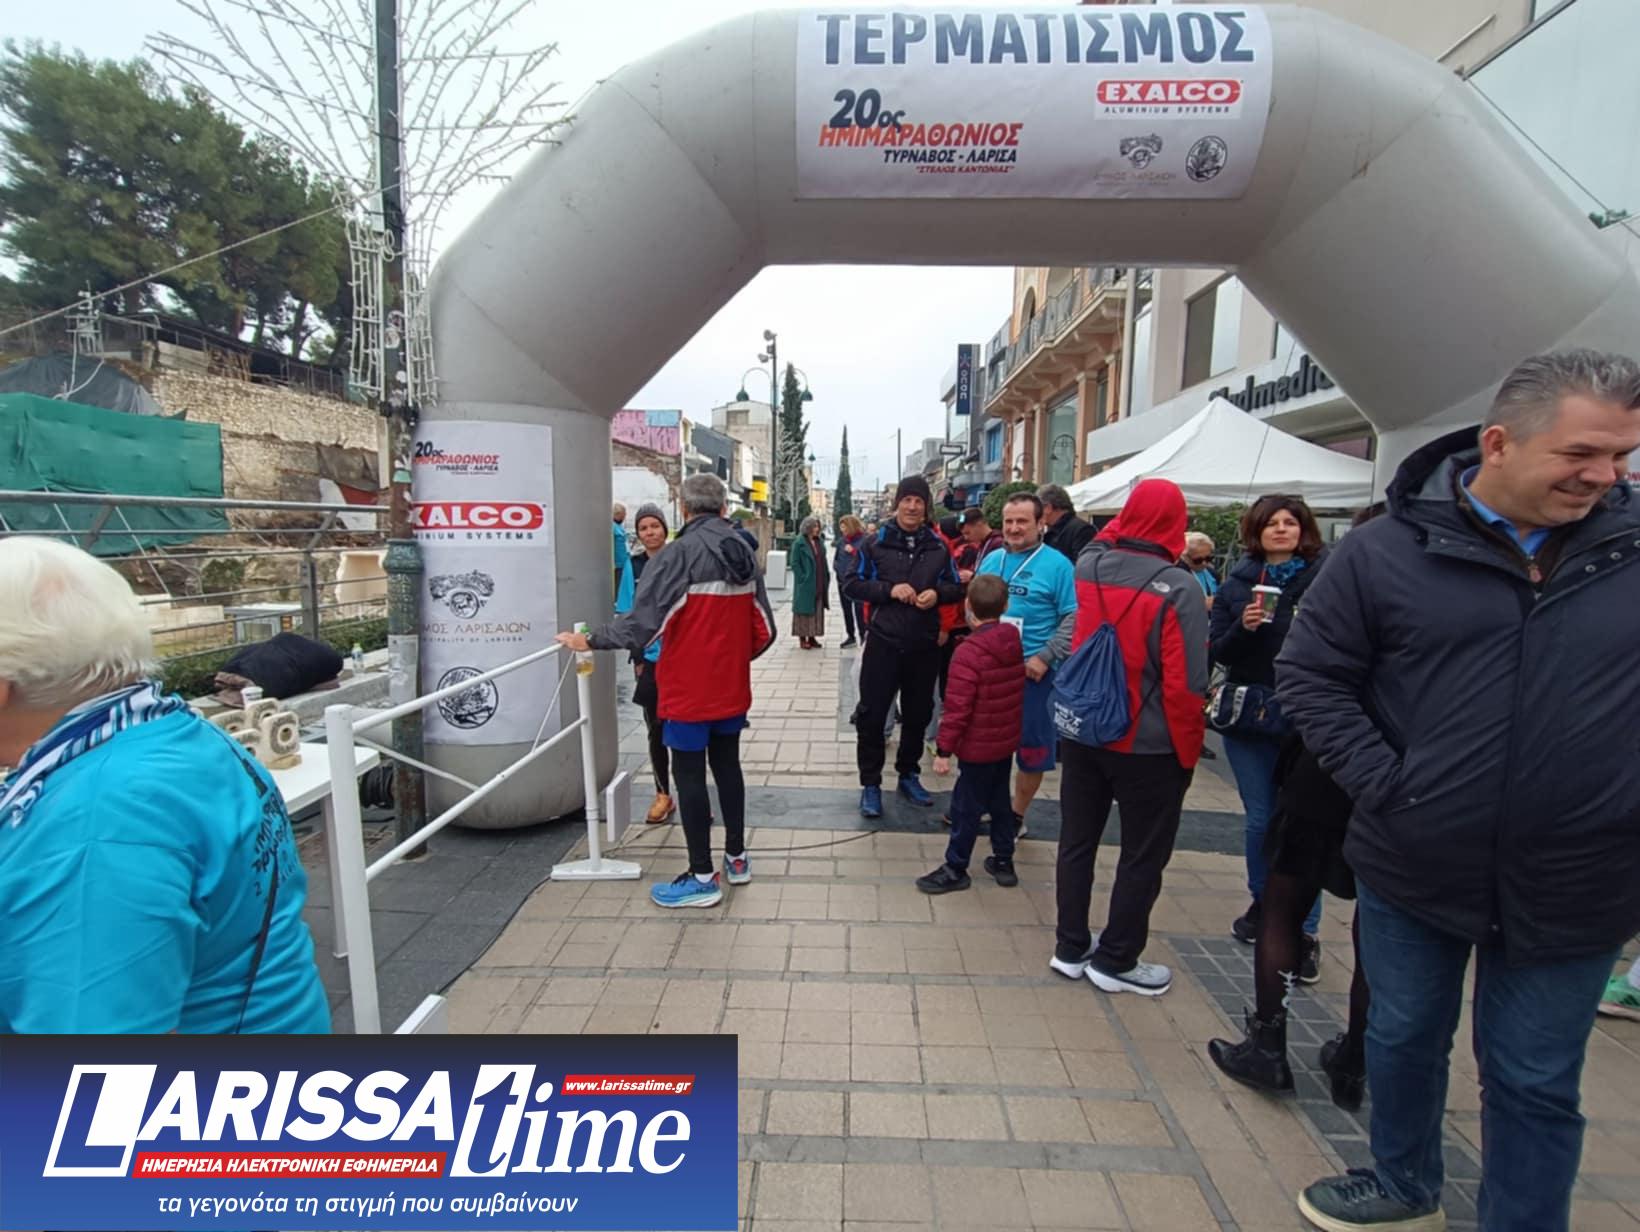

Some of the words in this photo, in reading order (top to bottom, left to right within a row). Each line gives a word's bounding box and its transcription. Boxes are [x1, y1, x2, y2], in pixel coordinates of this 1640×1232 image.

[816, 11, 1254, 64] ΤΕΡΜΑΤΙΣΜΟΣ
[1105, 82, 1231, 101] EXALCO
[829, 88, 905, 133] 20ος
[818, 122, 1023, 147] ΗΜΙΜΑΡΑΘΩΝΙΟΣ
[884, 149, 956, 163] ΤΥΡΝΑΒΟΣ
[966, 149, 1016, 162] ΛΑΡΙΣΑ
[409, 505, 532, 526] XALCO
[423, 623, 448, 633] ΜΟΣ
[455, 621, 531, 634] ΛΑΡΙΣΑΙΩΝ
